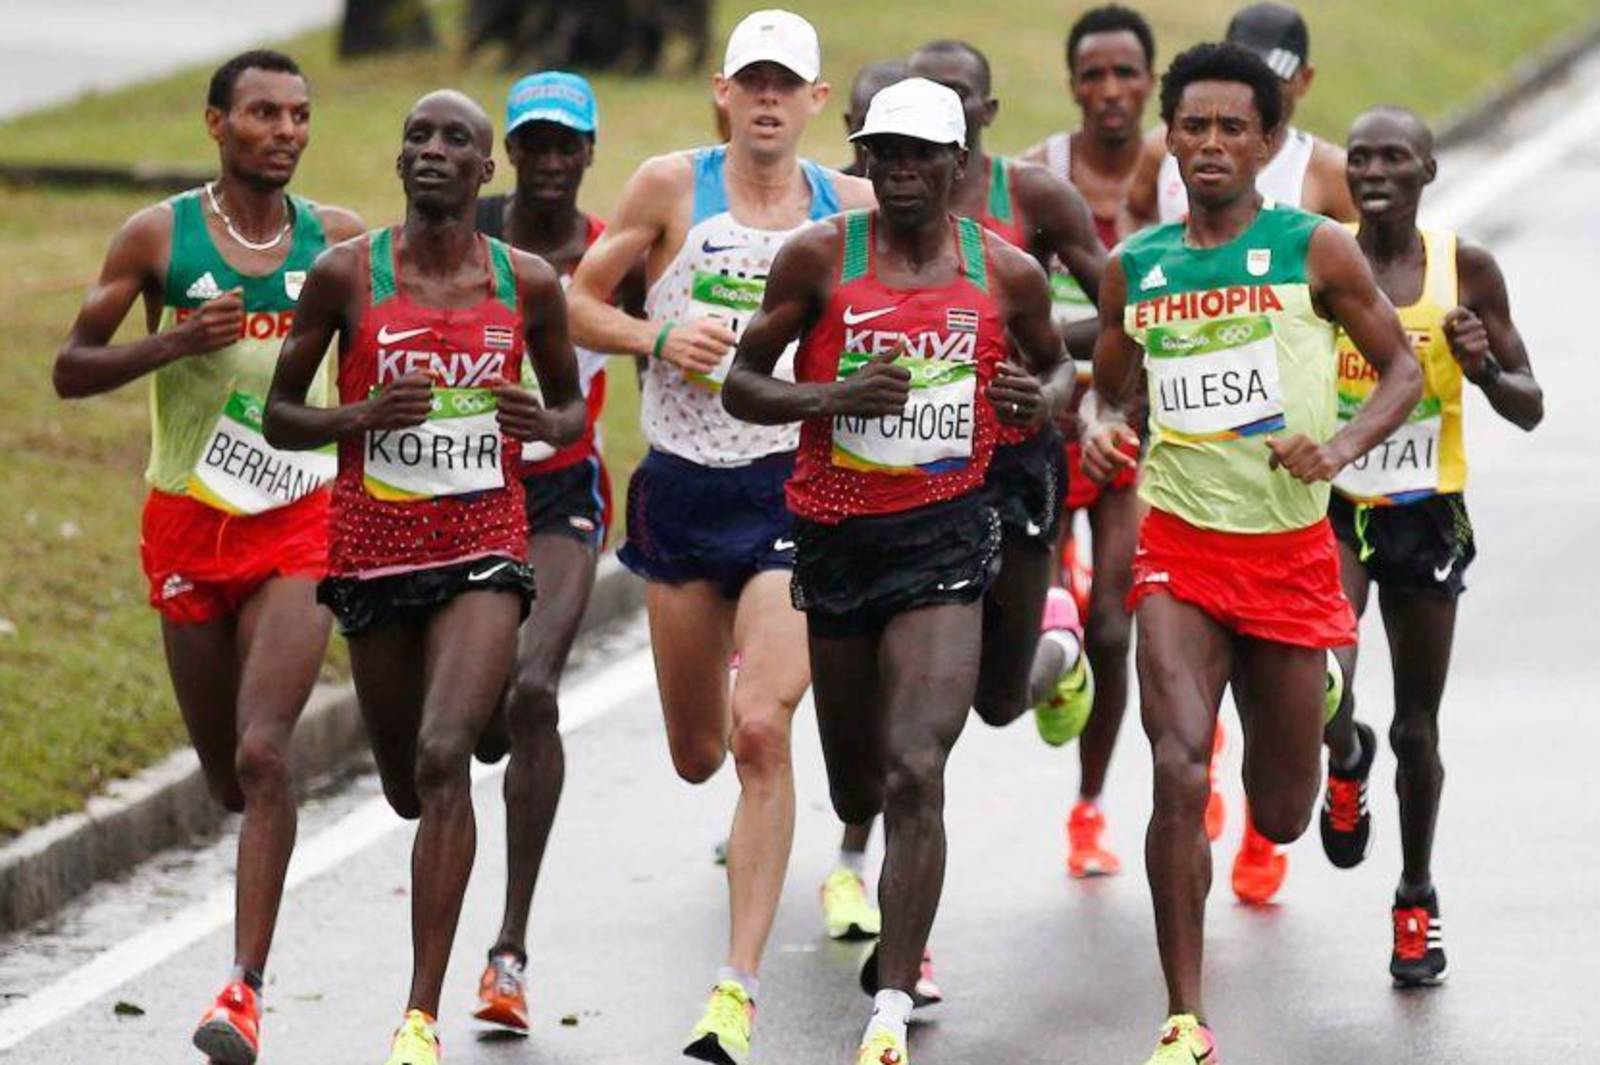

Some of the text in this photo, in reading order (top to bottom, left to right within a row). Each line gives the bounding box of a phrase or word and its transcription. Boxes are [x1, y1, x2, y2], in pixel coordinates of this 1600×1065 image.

[1135, 284, 1283, 328] ETHIOPIA
[845, 327, 978, 364] KENYA
[378, 349, 505, 387] KENYA
[1160, 369, 1268, 412] LILESA
[368, 429, 498, 470] KORIR
[1353, 437, 1433, 470] UTAI
